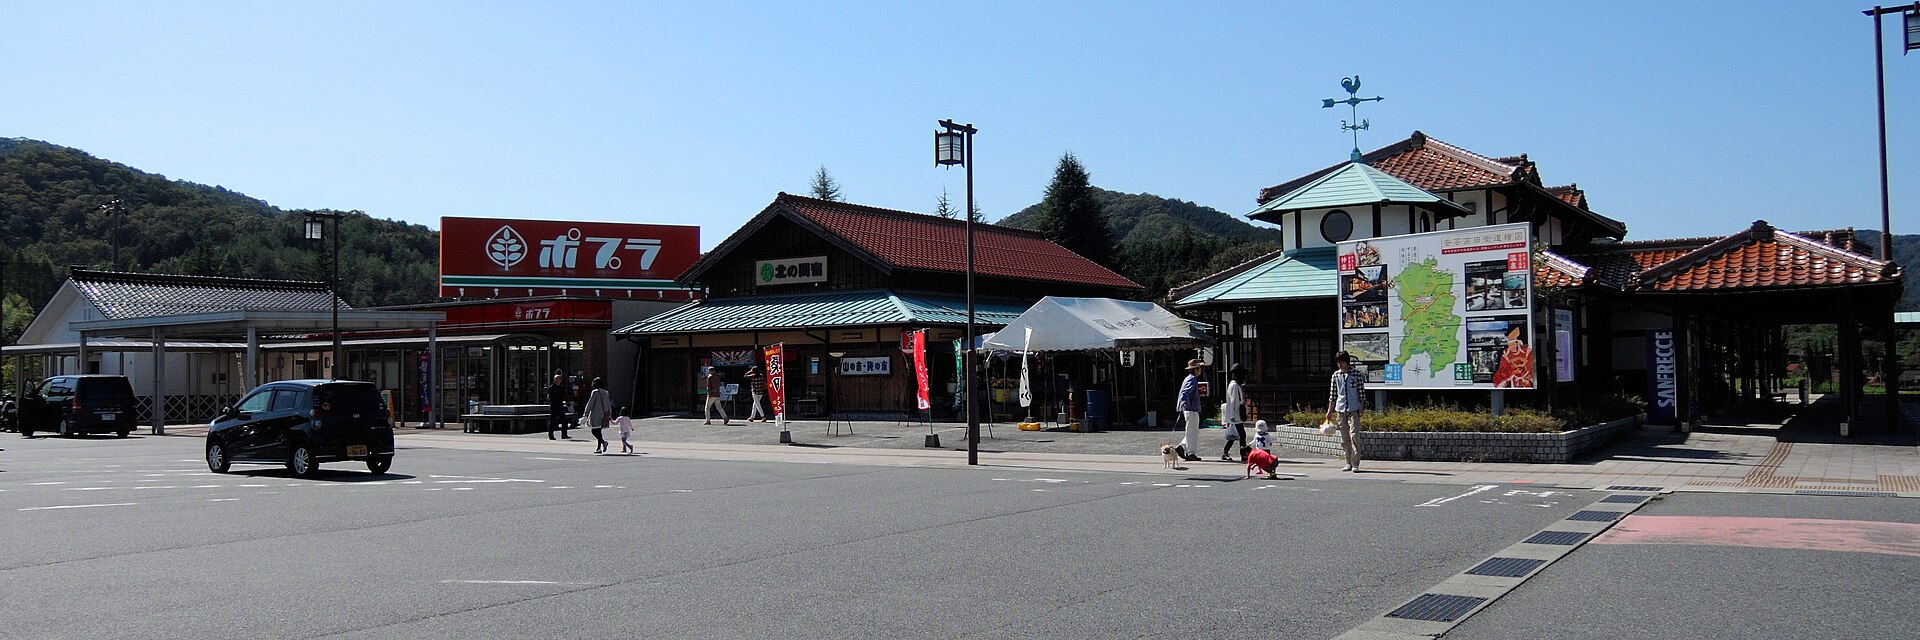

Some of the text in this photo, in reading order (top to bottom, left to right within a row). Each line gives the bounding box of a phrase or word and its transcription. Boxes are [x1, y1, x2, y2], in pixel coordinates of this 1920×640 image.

[539, 227, 662, 270] ポプラ
[525, 308, 551, 319] ポプラ
[1655, 332, 1674, 407] SANFRECCE
